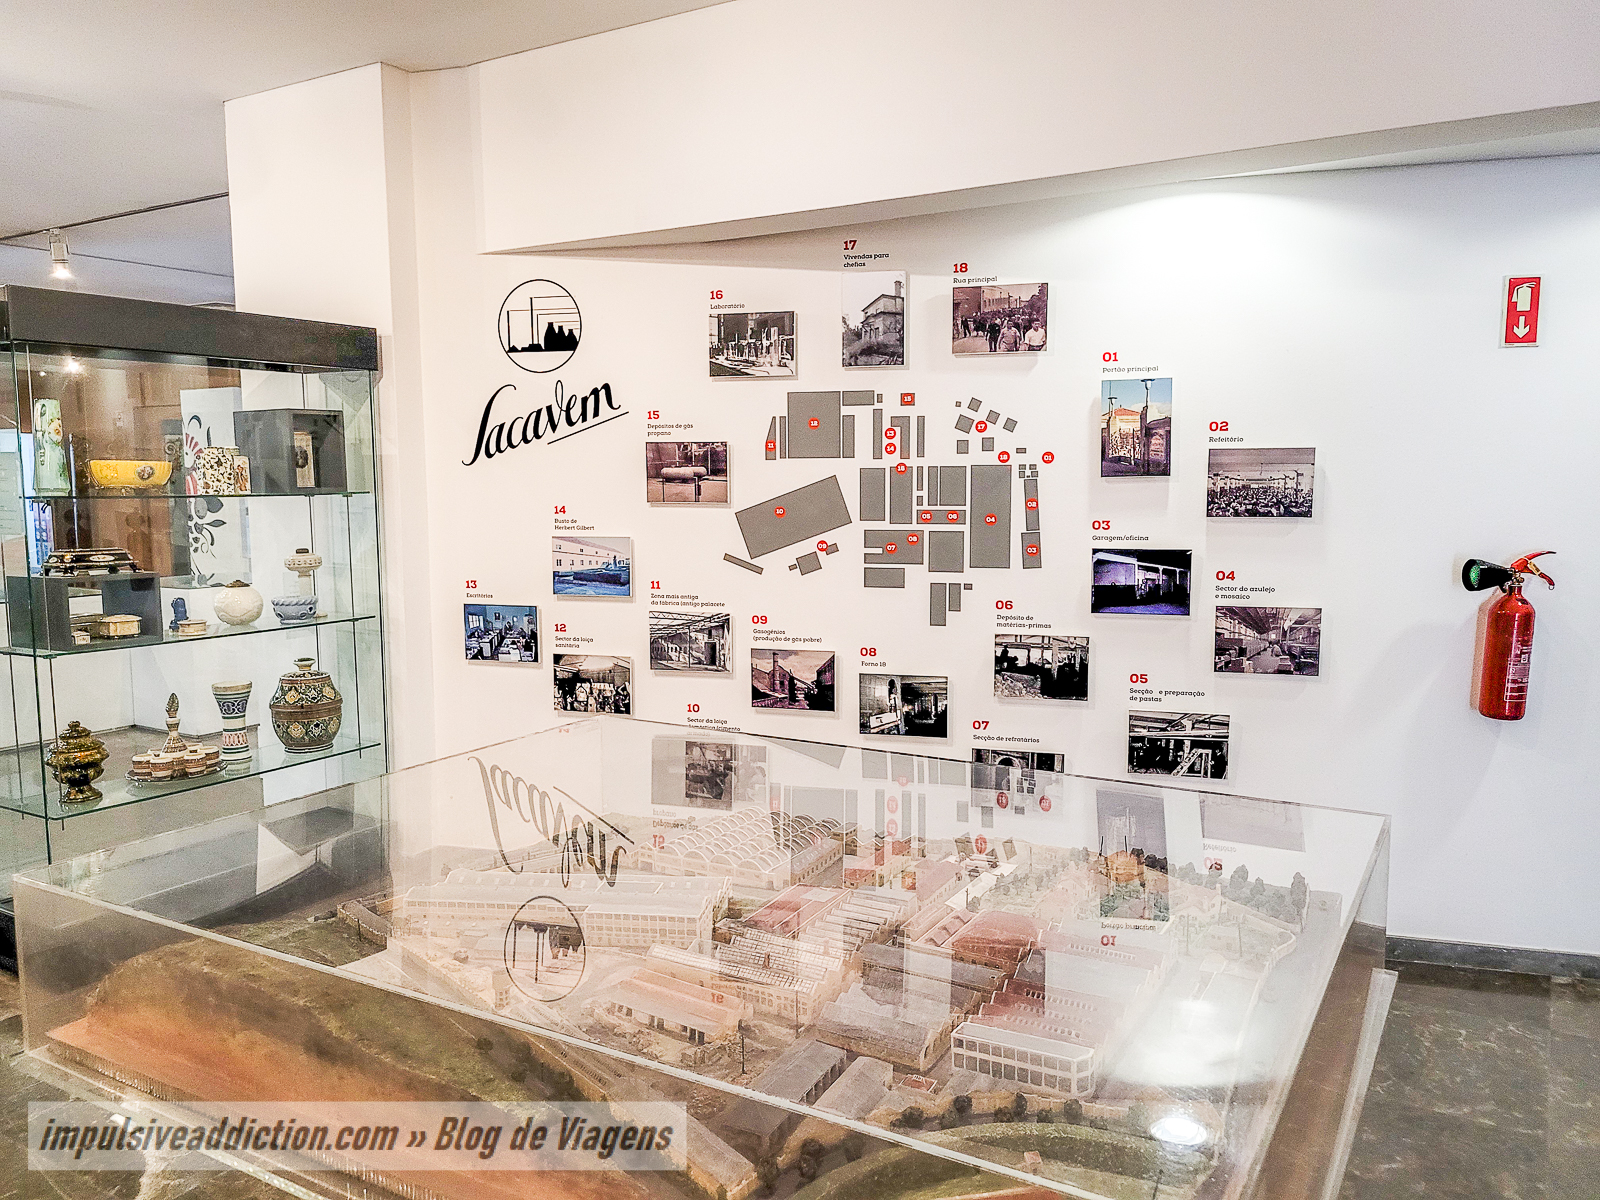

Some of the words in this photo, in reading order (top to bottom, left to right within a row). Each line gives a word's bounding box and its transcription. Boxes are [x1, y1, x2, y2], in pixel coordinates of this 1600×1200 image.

[843, 240, 857, 250] 17
[953, 262, 968, 273] 18
[967, 276, 998, 284] principal
[709, 290, 724, 300] 16
[1102, 352, 1119, 362] 01
[1127, 365, 1159, 373] principal
[647, 410, 660, 420] 15
[1209, 421, 1229, 432] 02
[554, 505, 567, 515] 14
[1091, 520, 1111, 531] 03
[1091, 535, 1149, 543] Garagem/oficina
[1215, 570, 1236, 581] 04
[465, 580, 478, 589] 13
[650, 580, 661, 590] 11
[1249, 586, 1276, 594] azulejo
[995, 600, 1014, 610] 06
[751, 615, 768, 625] 09
[554, 623, 567, 633] 12
[996, 622, 1052, 630] matérias-primas
[859, 647, 877, 657] 08
[1129, 673, 1149, 684] 05
[1164, 690, 1206, 698] preparação
[686, 703, 700, 713] 10
[972, 720, 990, 731] 07
